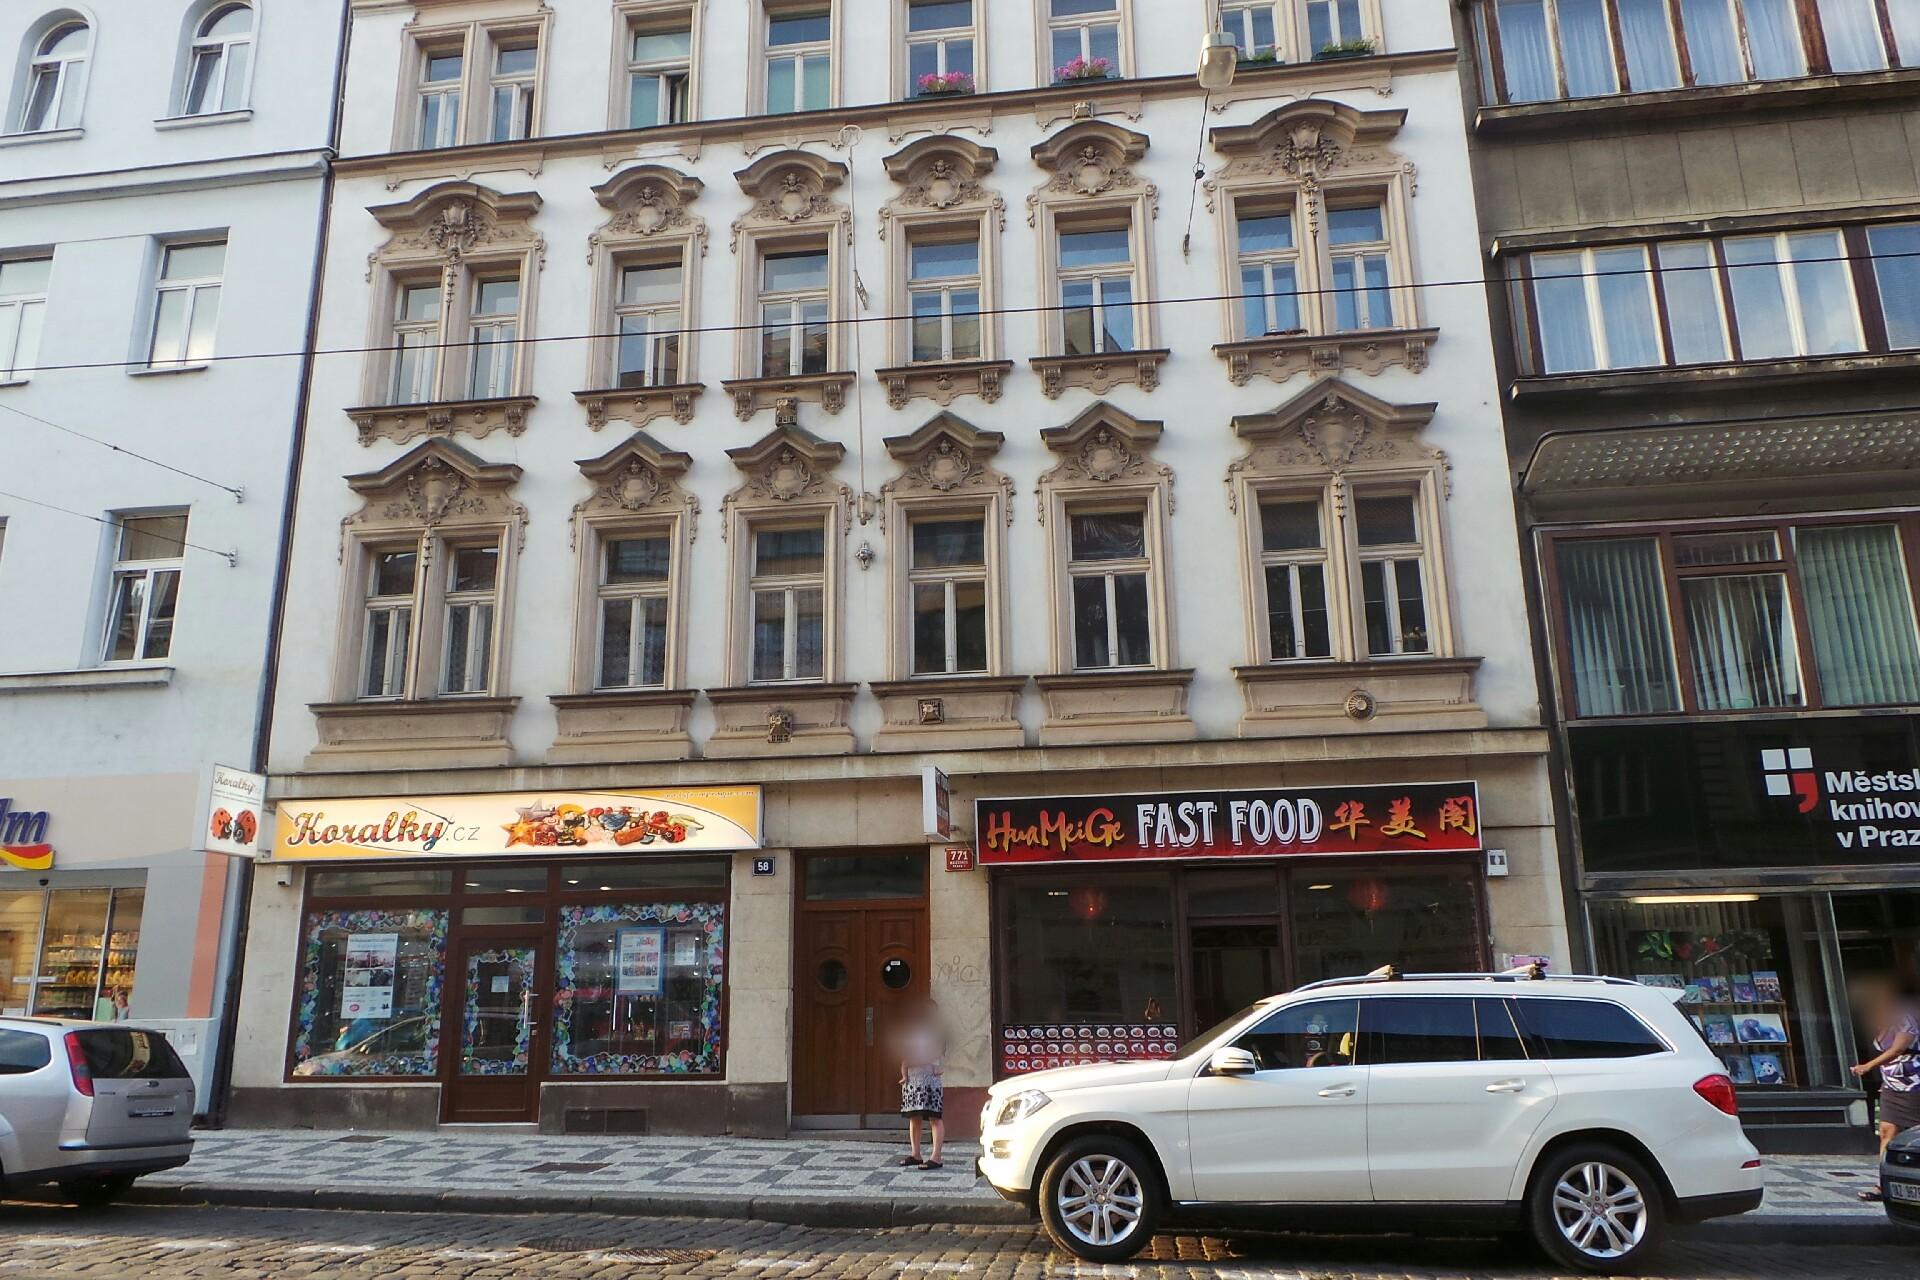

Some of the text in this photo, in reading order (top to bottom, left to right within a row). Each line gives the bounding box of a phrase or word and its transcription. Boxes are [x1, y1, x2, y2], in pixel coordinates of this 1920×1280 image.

[987, 798, 1323, 853] HuaMeiGe FAST FOOD
[1836, 831, 1853, 848] v
[951, 851, 968, 861] 771
[757, 861, 769, 872] 58
